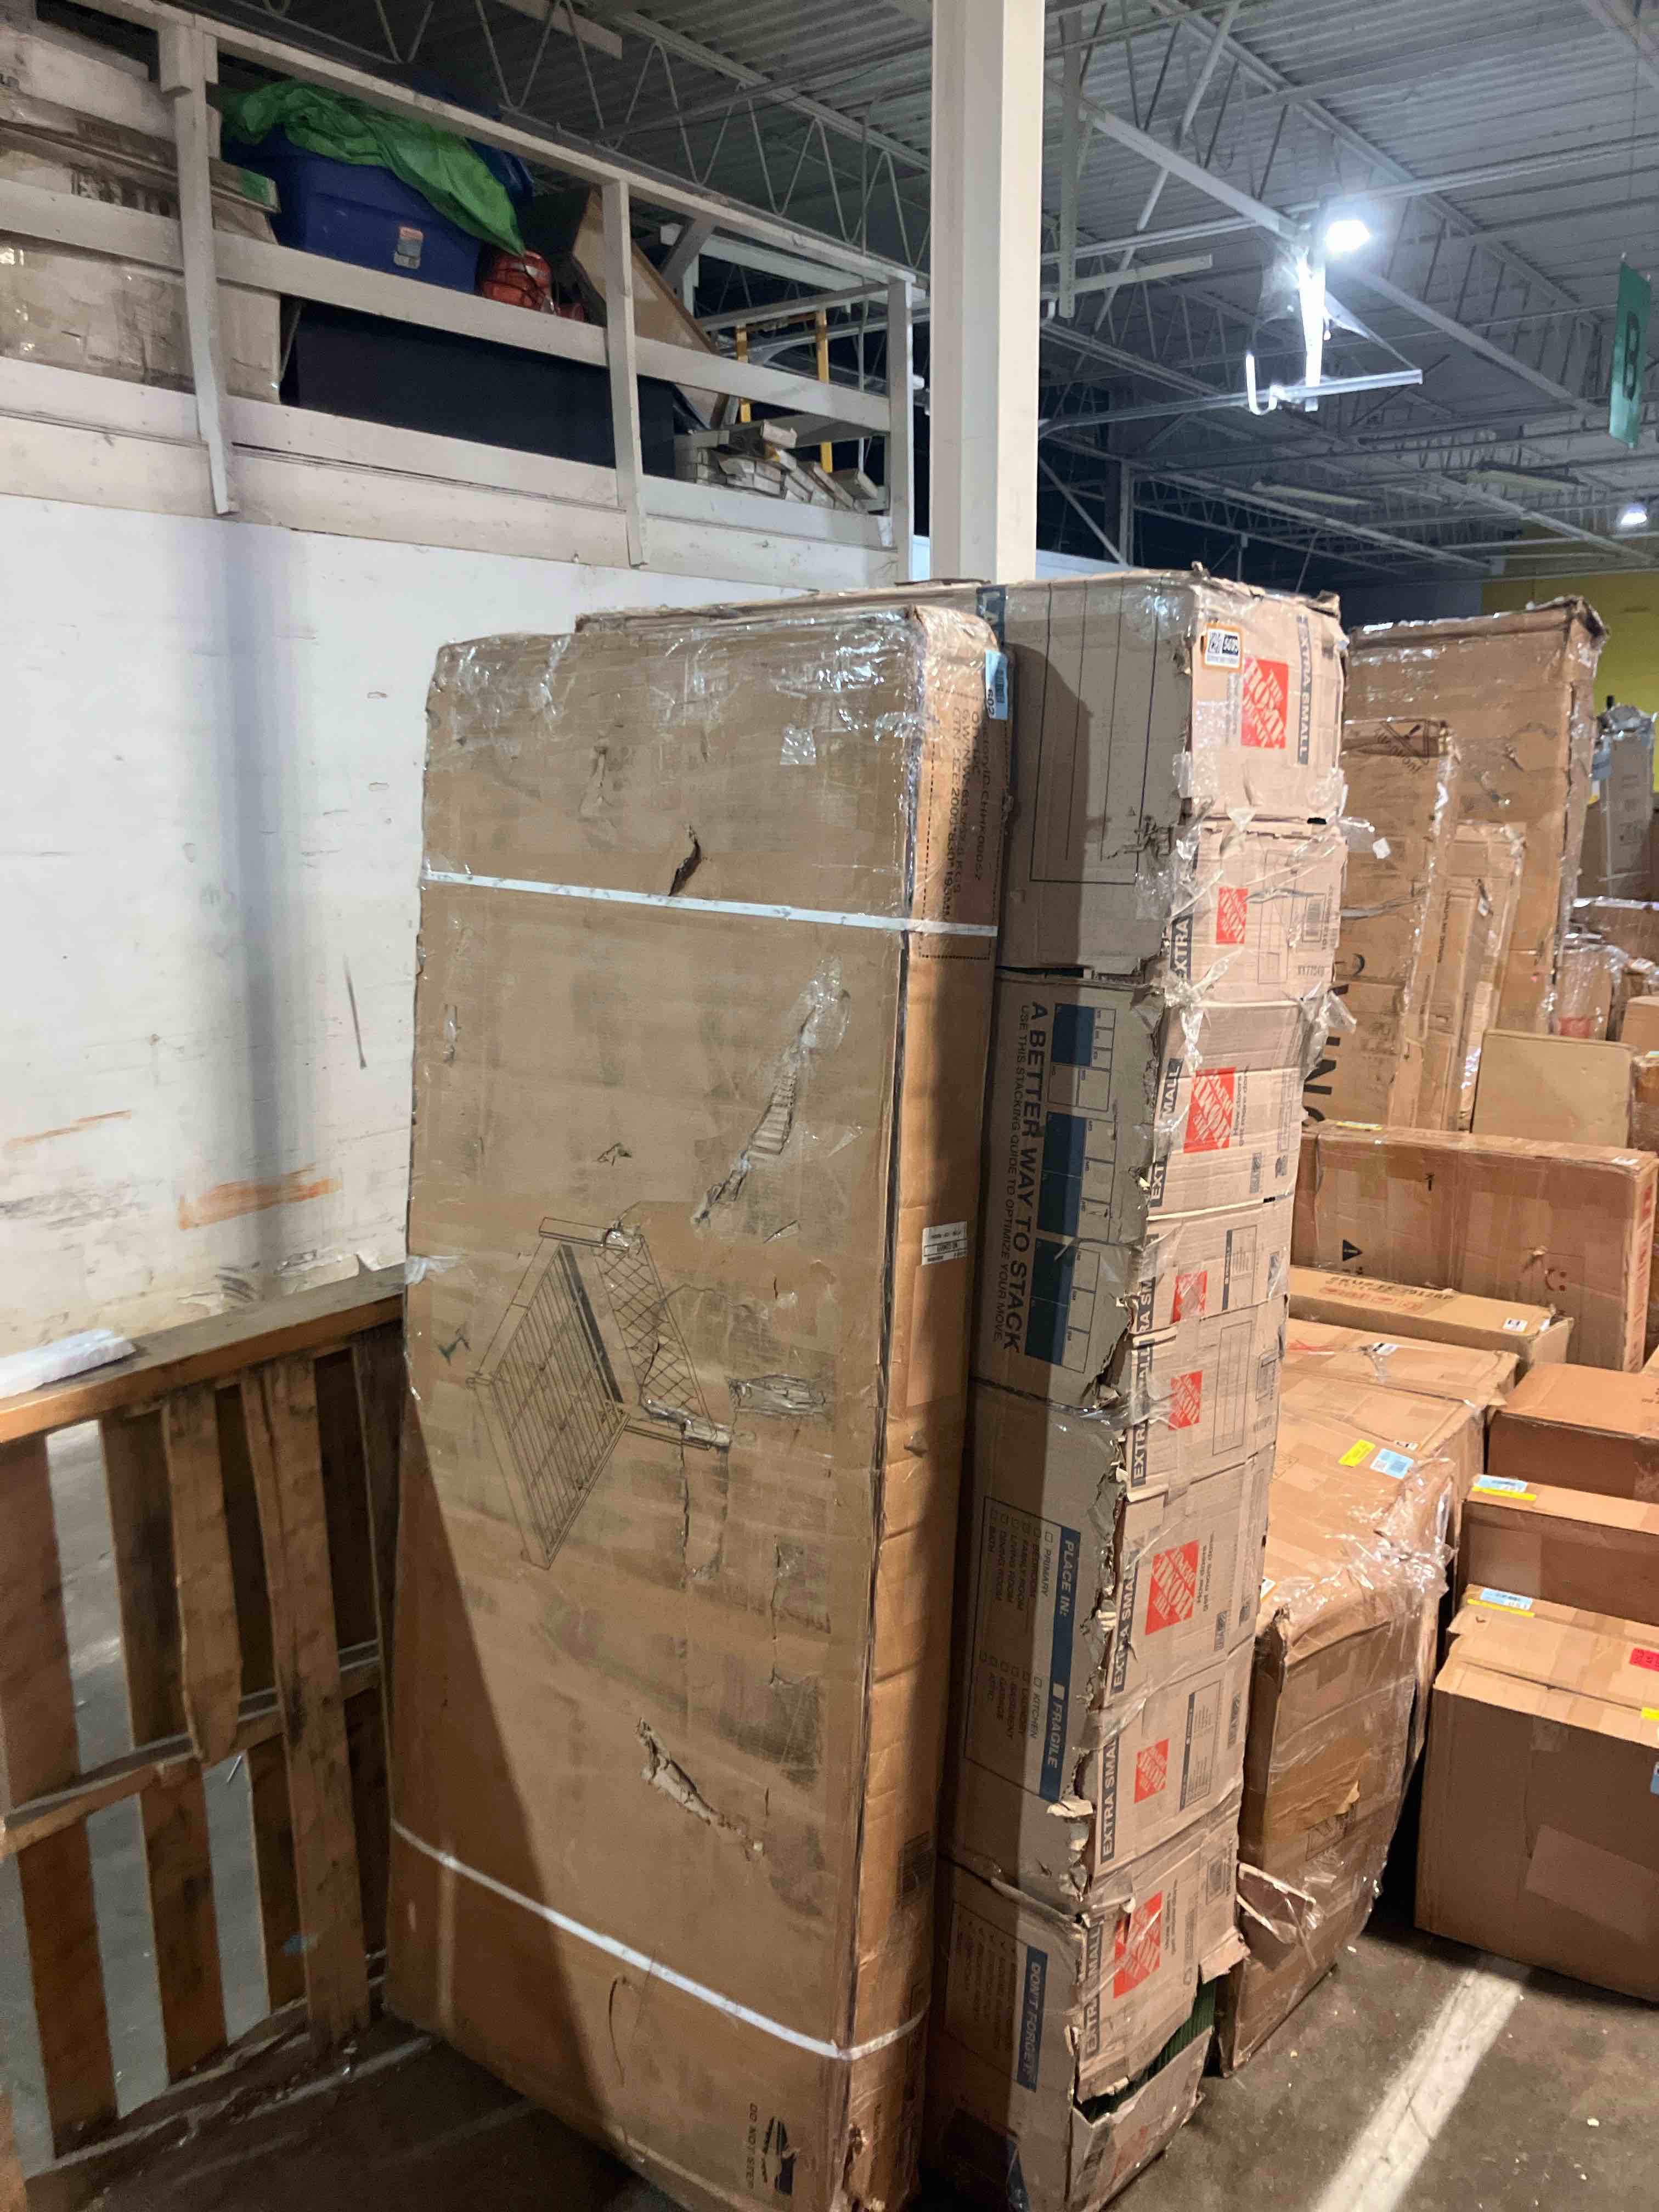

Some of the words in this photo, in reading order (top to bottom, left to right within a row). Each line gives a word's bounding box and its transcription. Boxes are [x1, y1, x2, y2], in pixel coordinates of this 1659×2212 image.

[1299, 691, 1310, 757] SMALL
[1018, 1005, 1028, 1031] USE
[1030, 1001, 1048, 1020] A
[1017, 1035, 1028, 1063] THIS
[1011, 1066, 1025, 1131] STACKING
[1022, 1030, 1046, 1137] BETTER
[1162, 1066, 1180, 1119] MALL
[1007, 1134, 1019, 1174] GUIDE
[1018, 1148, 1038, 1209] WAY
[1006, 1179, 1015, 1195] TO
[1001, 1199, 1014, 1260] OPTIMIZE
[1014, 1216, 1031, 1252] TO
[997, 1263, 1009, 1299] YOUR
[1003, 1260, 1028, 1353] STACK
[1040, 1548, 1051, 1598] PRIMARY
[1061, 1541, 1075, 1594] PLACE
[1197, 1579, 1205, 1604] How
[1059, 1595, 1071, 1620] IN:
[1030, 1692, 1041, 1740] KITCHEN
[1047, 1701, 1063, 1769] FRAGILE
[1102, 1792, 1115, 1858] EXTRA
[1028, 1962, 1041, 2010] DON'T
